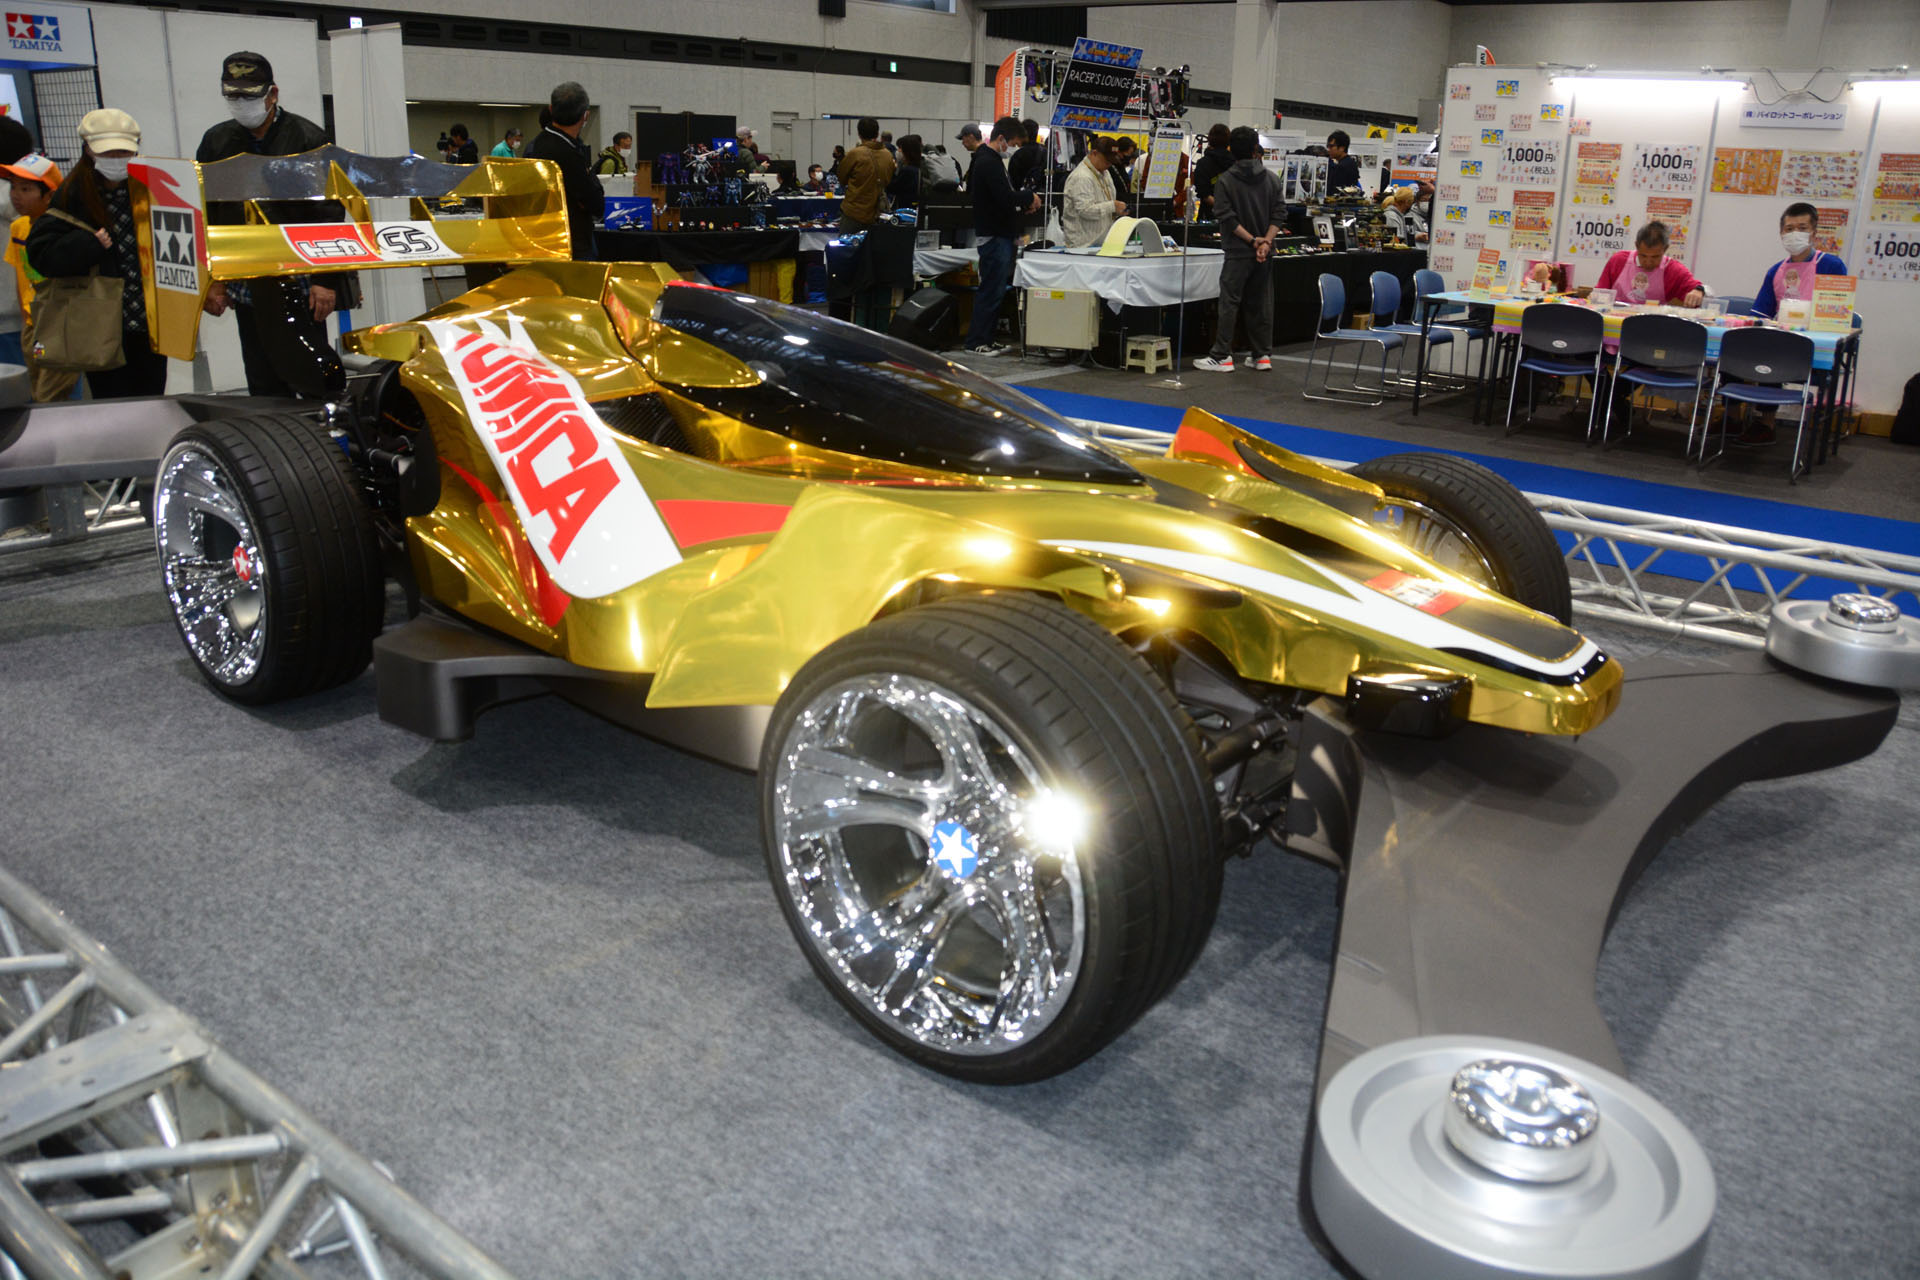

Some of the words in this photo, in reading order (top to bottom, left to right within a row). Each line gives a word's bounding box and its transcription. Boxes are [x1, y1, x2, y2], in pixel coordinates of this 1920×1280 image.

[9, 39, 63, 52] TAMIYA
[1068, 69, 1101, 85] RACER'S
[1101, 74, 1133, 88] LOUNGE
[1642, 153, 1693, 171] 1,000円
[1575, 221, 1625, 238] 1,000円
[296, 239, 367, 258] トミカ
[382, 230, 433, 253] 55
[156, 265, 198, 290] TAMIYA
